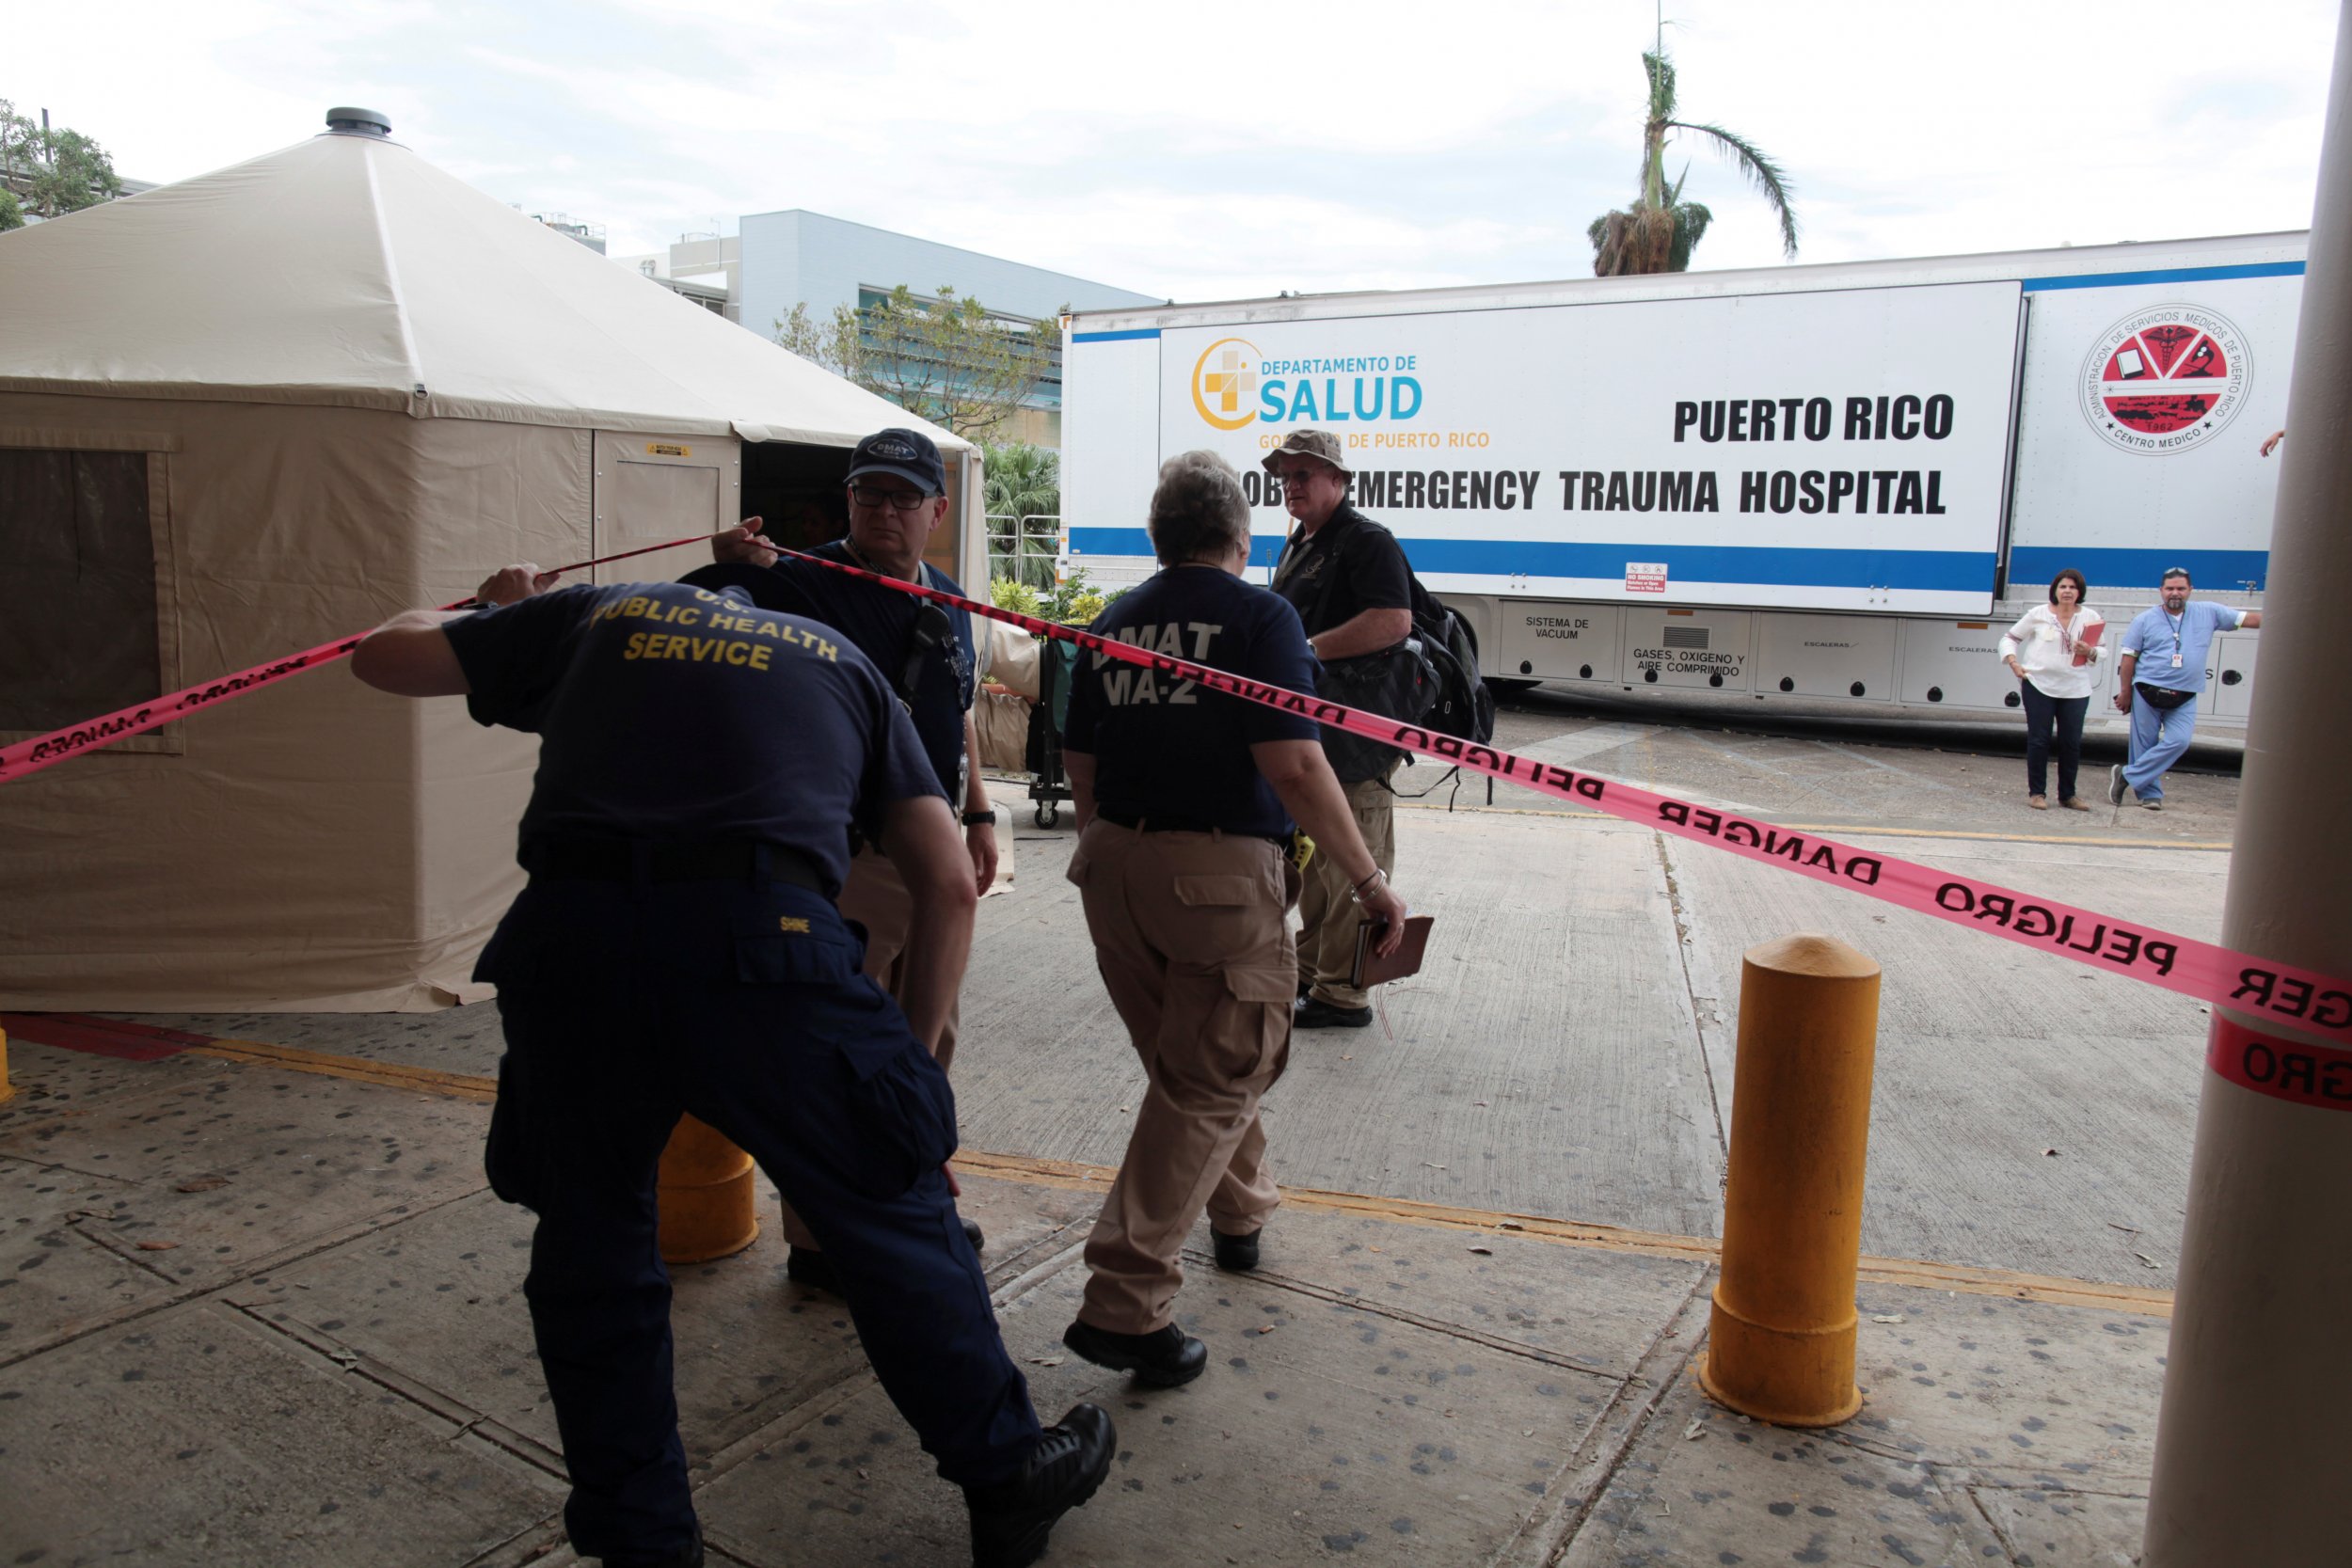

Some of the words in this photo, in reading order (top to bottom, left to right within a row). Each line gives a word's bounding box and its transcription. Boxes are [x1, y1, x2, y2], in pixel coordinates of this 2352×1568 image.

[2124, 311, 2179, 334] SERVICIOS
[2185, 313, 2227, 340] MEDICOS
[2111, 331, 2125, 344] DE
[2224, 341, 2237, 355] DE
[1262, 356, 1390, 375] DEPARTAMENTO
[1395, 356, 1416, 371] DE
[2228, 356, 2243, 394] PUERTO
[2089, 346, 2112, 420] ADMINISTRACION
[1260, 376, 1422, 422] SALUD
[2215, 395, 2235, 418] RICO
[1674, 397, 1832, 443] PUERTO
[1844, 393, 1954, 440] RICO
[1348, 434, 1369, 449] DE
[1375, 432, 1440, 449] PUERTO
[1449, 432, 1489, 448] RICO
[2114, 429, 2154, 449] CENTRO
[2158, 428, 2201, 449] MEDICO
[1559, 470, 1720, 513] TRAUMA
[1740, 470, 1947, 514] HOSPITAL
[694, 588, 751, 614] U.S.
[1526, 616, 1570, 628] SISTEMA
[1574, 619, 1589, 629] DE
[707, 613, 839, 663] HEALTH
[1535, 629, 1578, 640] VACUUM
[623, 632, 773, 671] SERVICE
[1633, 648, 1675, 661] GASES,
[1679, 651, 1732, 664] OXIGENO
[1738, 656, 1745, 665] Y
[1637, 661, 1661, 671] AIRE
[1667, 662, 1740, 676] COMPRIMIDO
